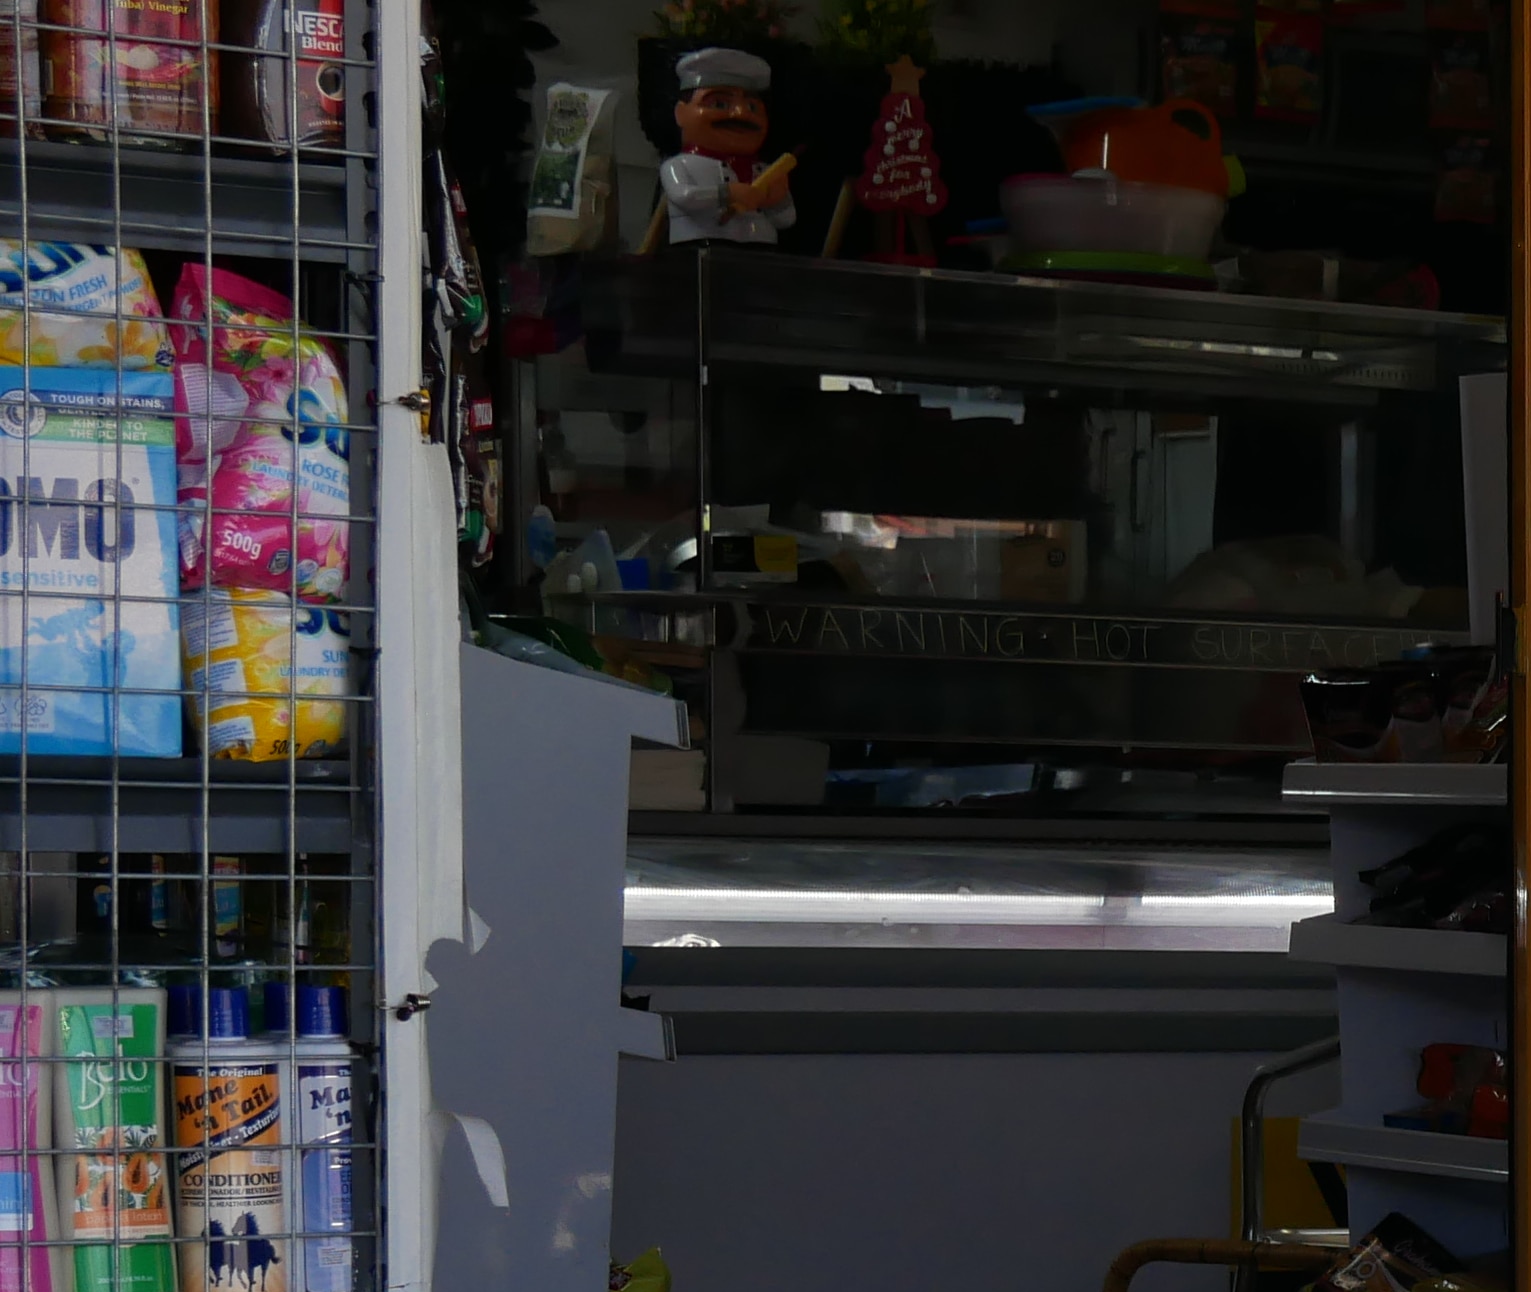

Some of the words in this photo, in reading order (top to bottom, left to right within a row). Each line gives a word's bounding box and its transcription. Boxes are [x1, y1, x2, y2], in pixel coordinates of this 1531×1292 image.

[149, 0, 188, 14] Vinegar
[284, 10, 343, 37] NESC
[69, 274, 108, 300] FRESH
[51, 394, 93, 405] TOUGH
[97, 396, 116, 406] ON
[70, 429, 93, 439] THE
[98, 431, 148, 441] PLNET
[72, 418, 117, 429] KINDE
[126, 421, 143, 431] TO
[302, 458, 339, 482] ROSE
[0, 477, 136, 563] MO
[222, 529, 262, 560] 500g
[1, 571, 98, 587] sensitive
[766, 607, 1025, 656] WARNING
[1072, 620, 1162, 660] HOT
[270, 739, 301, 755] 50g
[77, 1044, 149, 1110] Belo
[220, 1067, 263, 1079] Original
[222, 1083, 273, 1122] Tail
[310, 1086, 351, 1110] Ma
